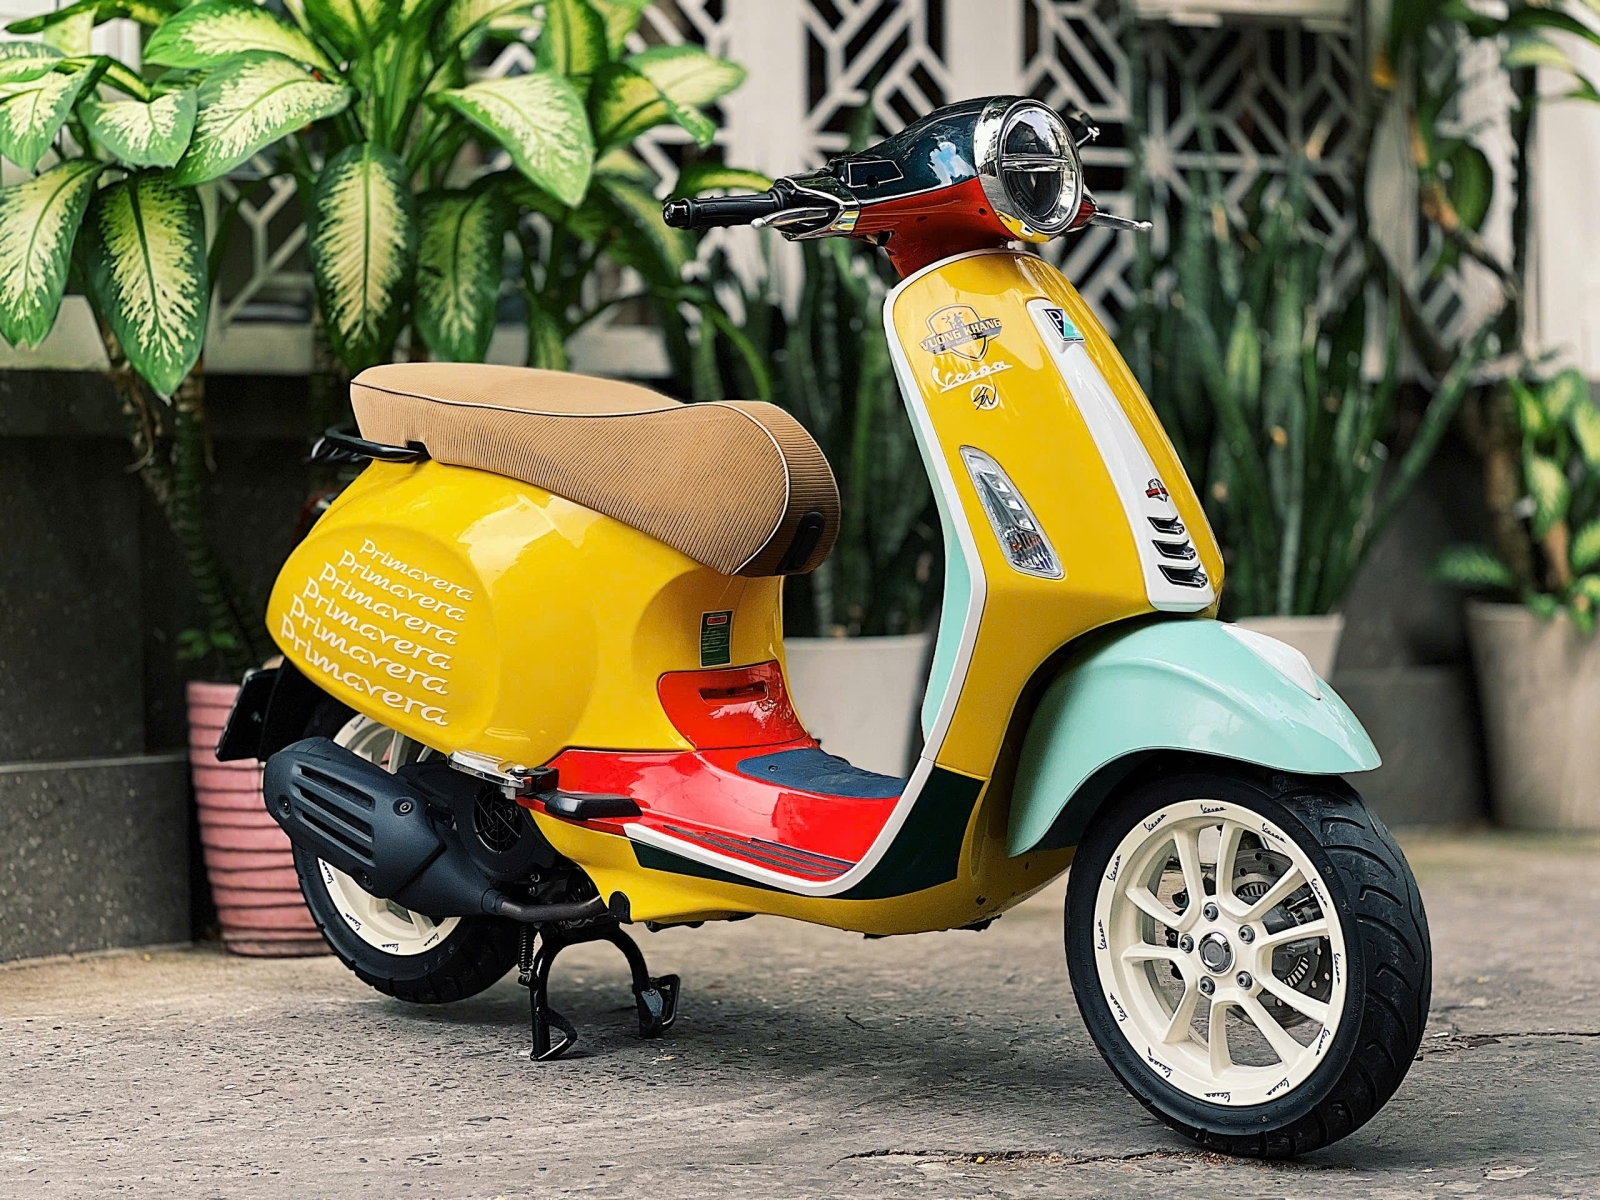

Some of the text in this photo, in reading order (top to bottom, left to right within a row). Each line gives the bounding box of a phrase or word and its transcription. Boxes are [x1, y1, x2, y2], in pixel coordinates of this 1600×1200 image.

[964, 319, 1001, 335] KHANG
[931, 361, 1013, 393] Vespa
[319, 562, 459, 645] Primavera
[338, 550, 467, 621] Primavera
[359, 538, 473, 601] Primavera
[289, 594, 450, 695] Primavera
[302, 576, 451, 670] Primavera
[281, 613, 449, 726] Primavera
